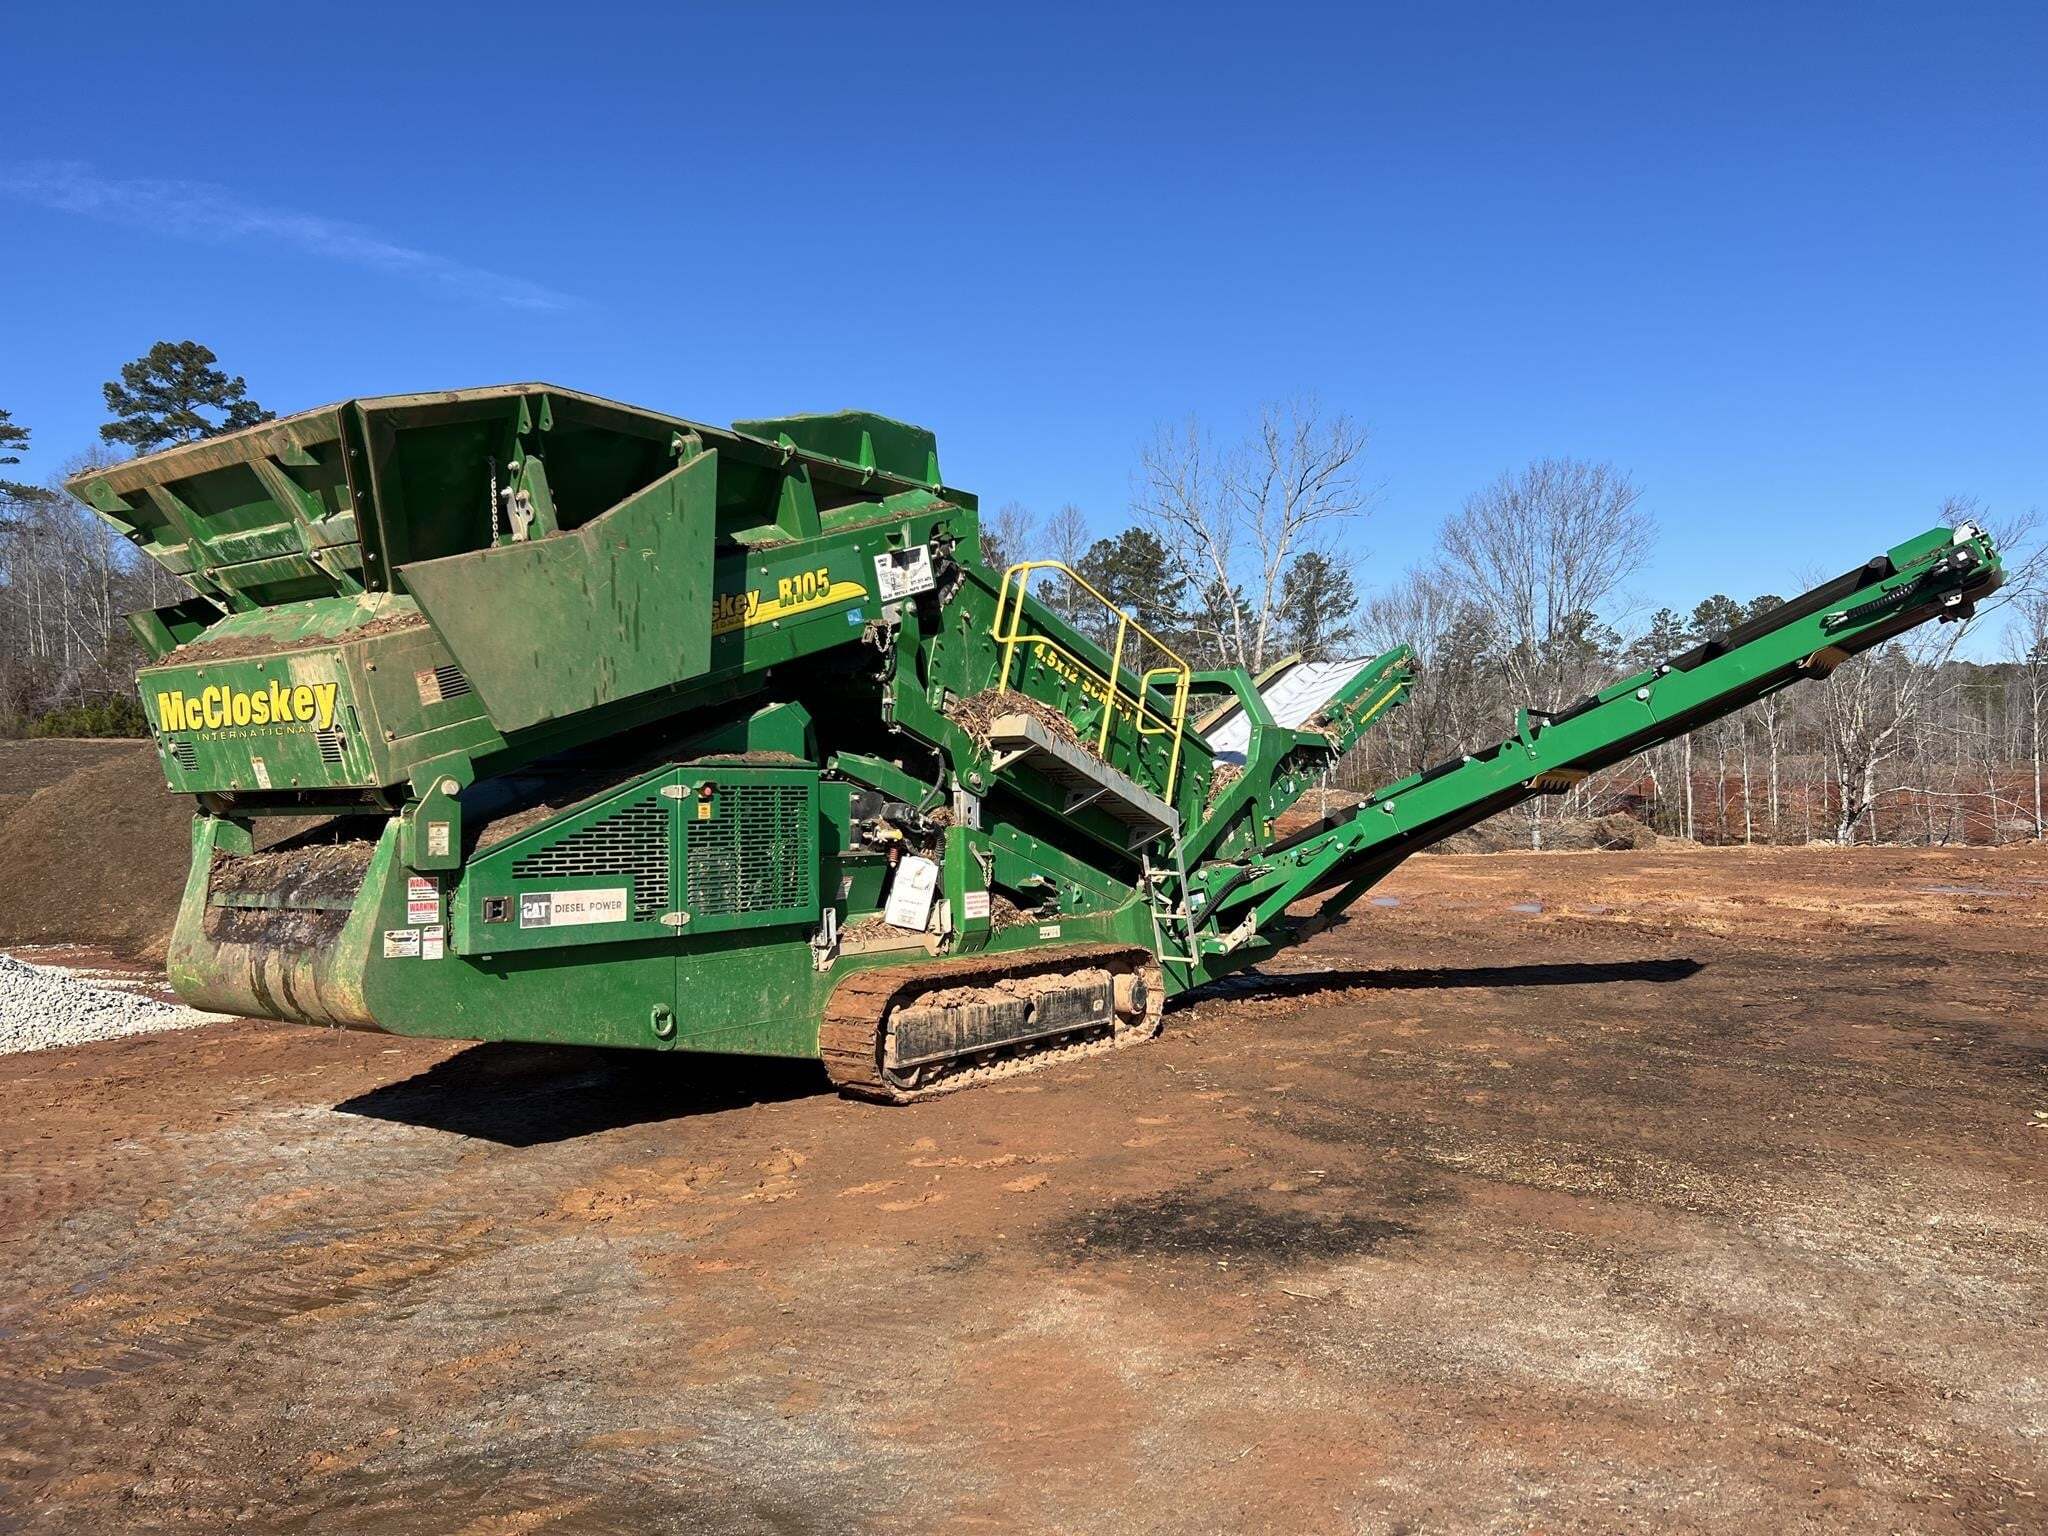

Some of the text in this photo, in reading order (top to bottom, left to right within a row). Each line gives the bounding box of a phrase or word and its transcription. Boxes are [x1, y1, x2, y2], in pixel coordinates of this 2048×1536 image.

[778, 567, 831, 608] R105
[1034, 643, 1079, 684] 4.5x12
[157, 680, 338, 733] McCloskey
[197, 725, 318, 742] INTERNATIONAL
[409, 878, 438, 889] WARNING
[409, 902, 438, 913] WARNING
[522, 900, 623, 919] CAT DIESEL POWER
